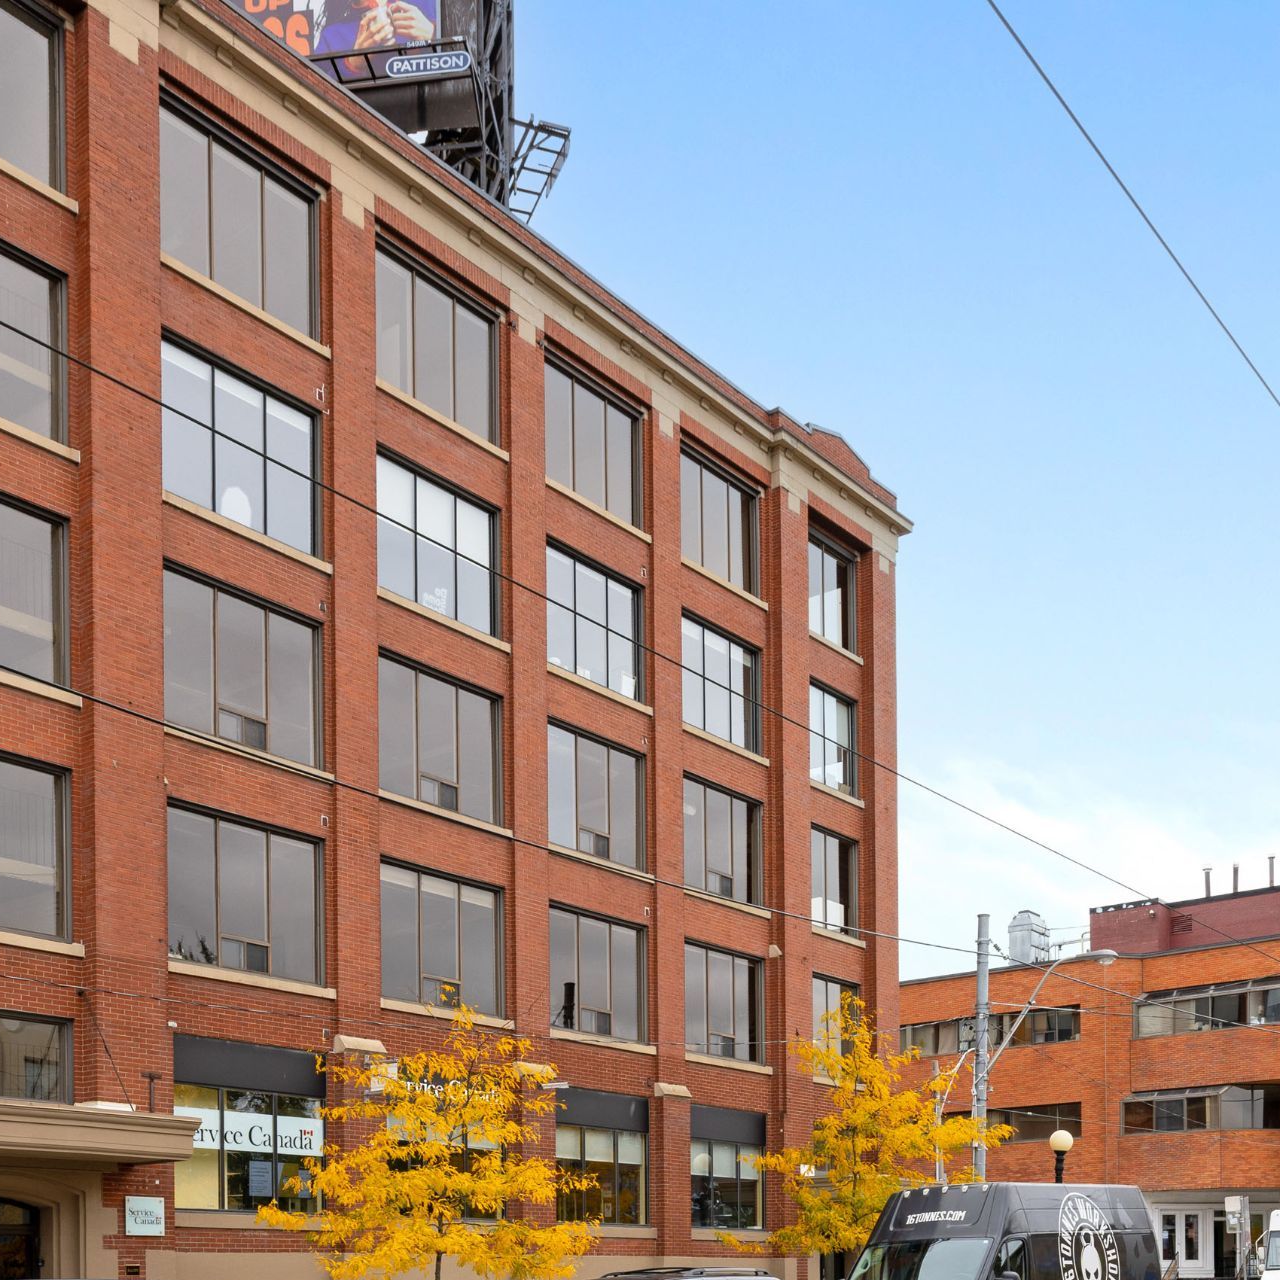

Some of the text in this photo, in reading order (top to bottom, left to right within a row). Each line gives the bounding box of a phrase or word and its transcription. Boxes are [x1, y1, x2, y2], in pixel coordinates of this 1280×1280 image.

[392, 55, 464, 73] PATTISON
[248, 1125, 314, 1150] Canada
[128, 1207, 154, 1217] Service
[905, 1210, 967, 1225] 16TONNES.COM
[134, 1217, 162, 1225] Canada
